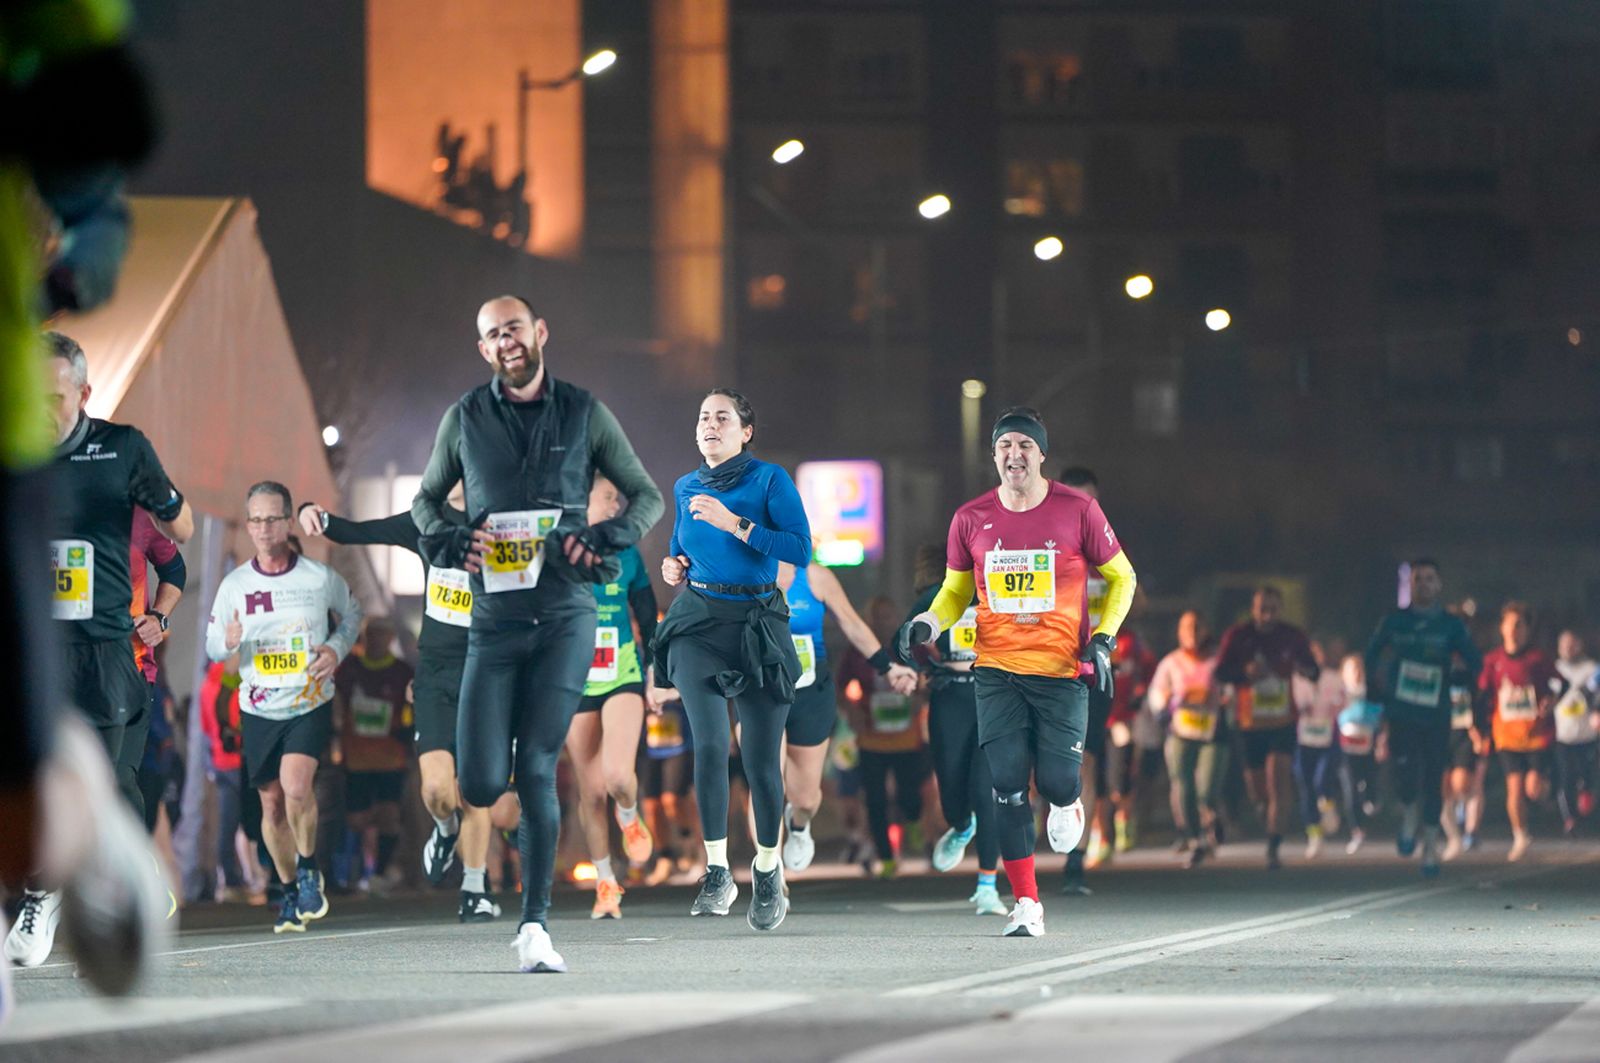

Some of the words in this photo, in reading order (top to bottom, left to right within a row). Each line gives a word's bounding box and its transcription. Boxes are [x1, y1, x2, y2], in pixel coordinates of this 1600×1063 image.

[1005, 572, 1034, 592] 972
[437, 585, 471, 608] 7830
[263, 653, 297, 670] 8758
